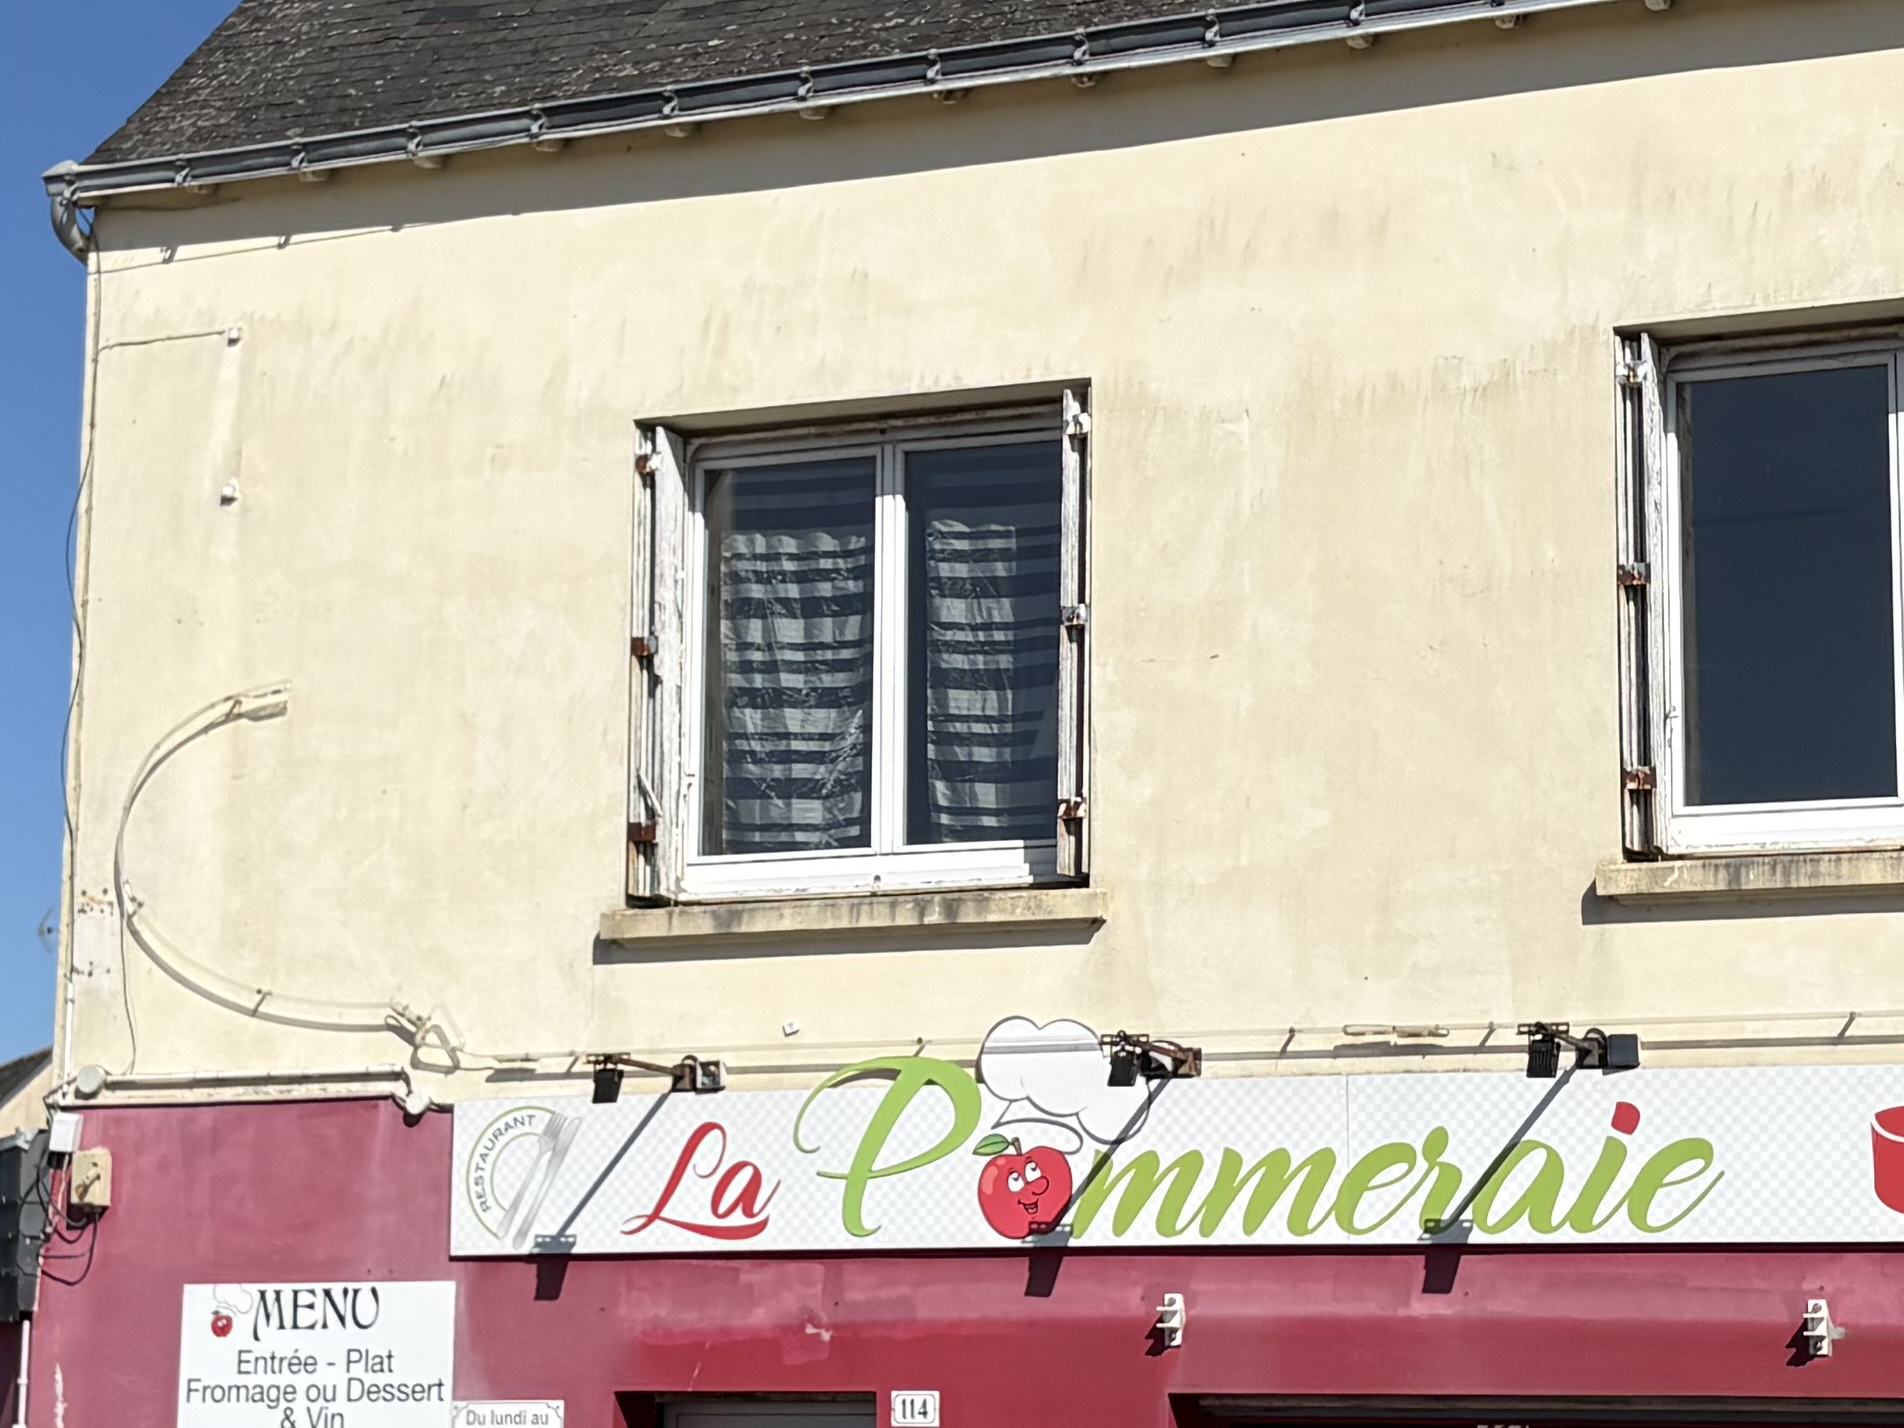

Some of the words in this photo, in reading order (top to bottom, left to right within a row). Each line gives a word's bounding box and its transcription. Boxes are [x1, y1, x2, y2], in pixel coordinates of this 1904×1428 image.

[474, 1114, 536, 1213] RESTAURANT
[621, 1122, 780, 1240] La
[253, 1286, 380, 1342] MENU
[237, 1348, 318, 1375] Entrée
[346, 1348, 394, 1374] Plat
[186, 1378, 297, 1410] Fromage
[305, 1384, 337, 1403] ou
[346, 1377, 445, 1403] Dessert
[902, 1398, 928, 1420] 114
[466, 1410, 486, 1425] Du
[491, 1410, 527, 1425] lundi
[531, 1413, 549, 1425] au
